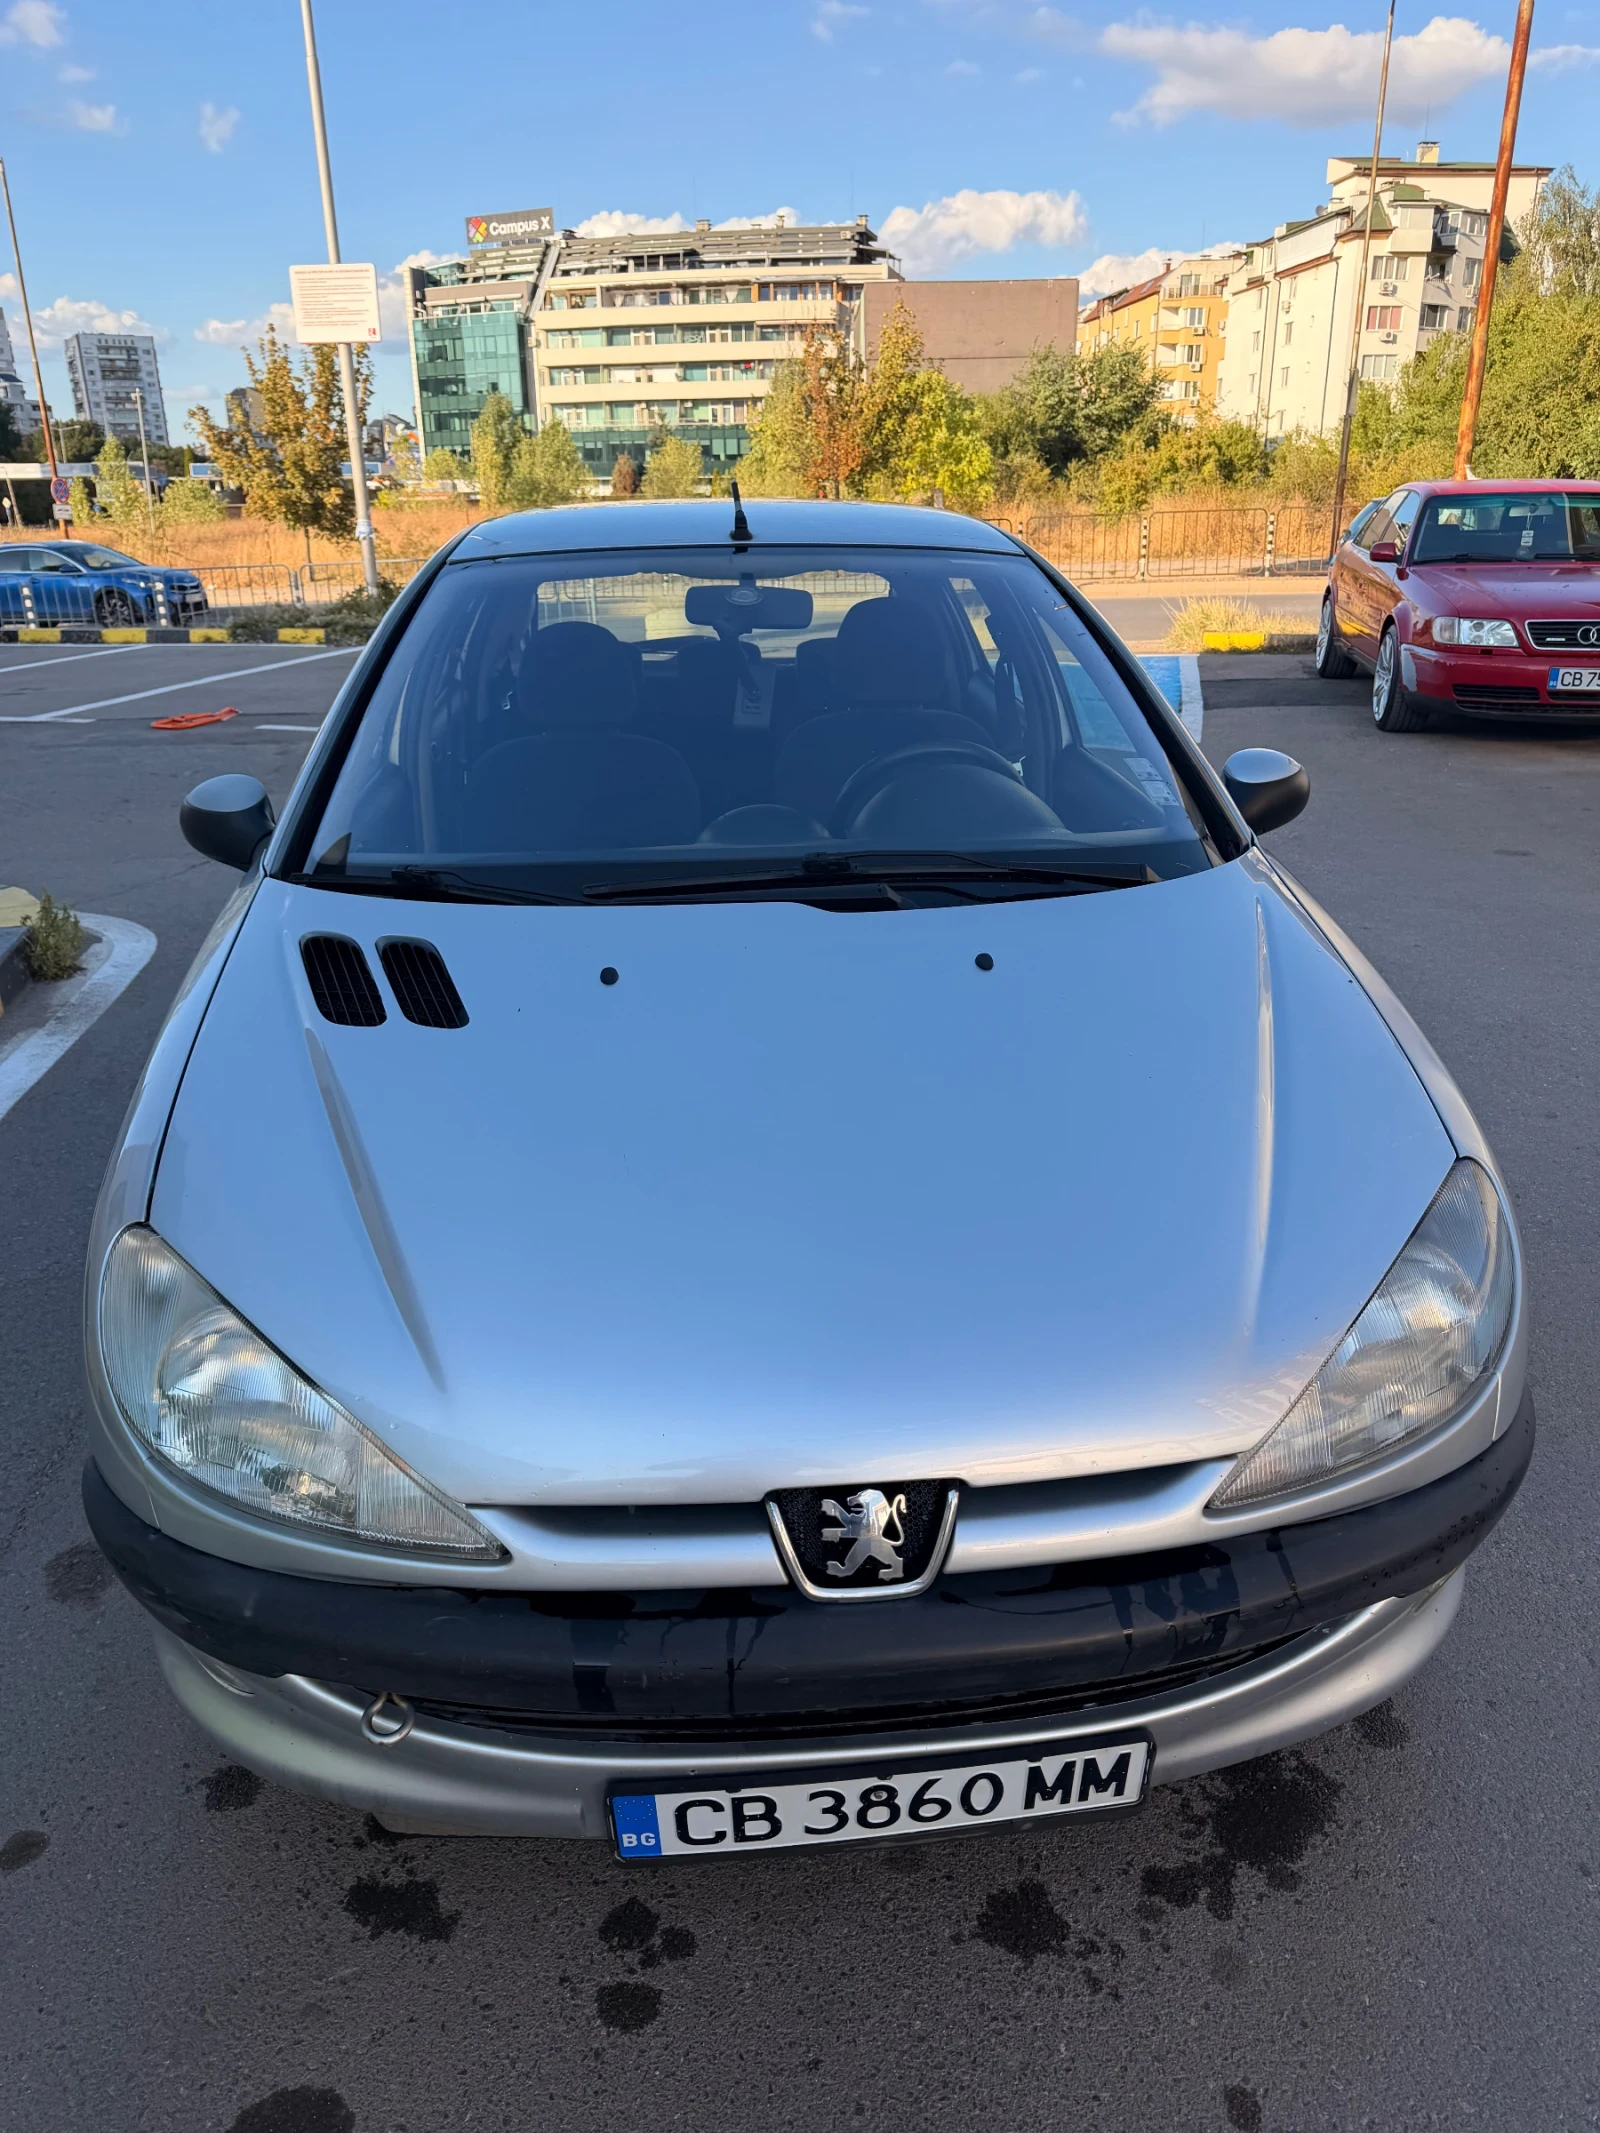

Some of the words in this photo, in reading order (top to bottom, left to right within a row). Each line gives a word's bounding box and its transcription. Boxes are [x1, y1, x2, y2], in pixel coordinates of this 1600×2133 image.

[489, 219, 540, 236] Campus
[540, 215, 551, 230] X
[1560, 671, 1583, 687] CB
[674, 1794, 783, 1846] CB
[804, 1771, 1004, 1835] 3860
[1023, 1751, 1132, 1811] MM
[621, 1832, 656, 1848] BG
